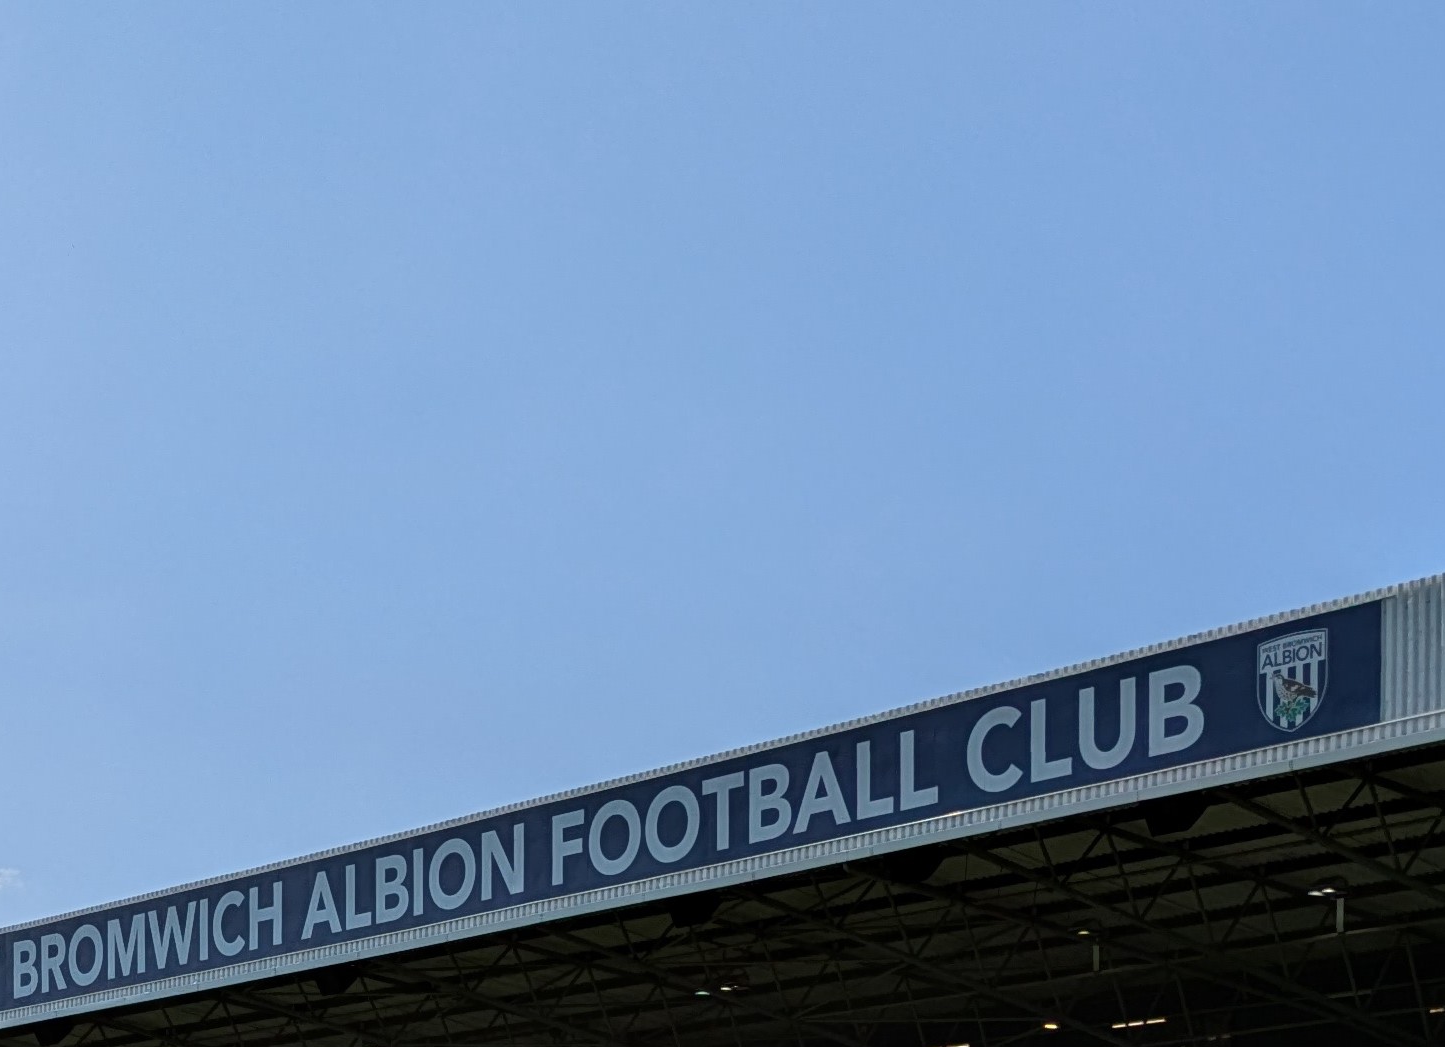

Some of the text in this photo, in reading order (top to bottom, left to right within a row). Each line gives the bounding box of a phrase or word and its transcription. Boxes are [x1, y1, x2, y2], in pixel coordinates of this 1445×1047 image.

[1262, 641, 1323, 670] ALBION
[12, 880, 284, 1000] BROMWICH
[301, 822, 525, 941] ALBION
[551, 728, 939, 886] FOOTBALL
[966, 663, 1205, 793] CLUB
